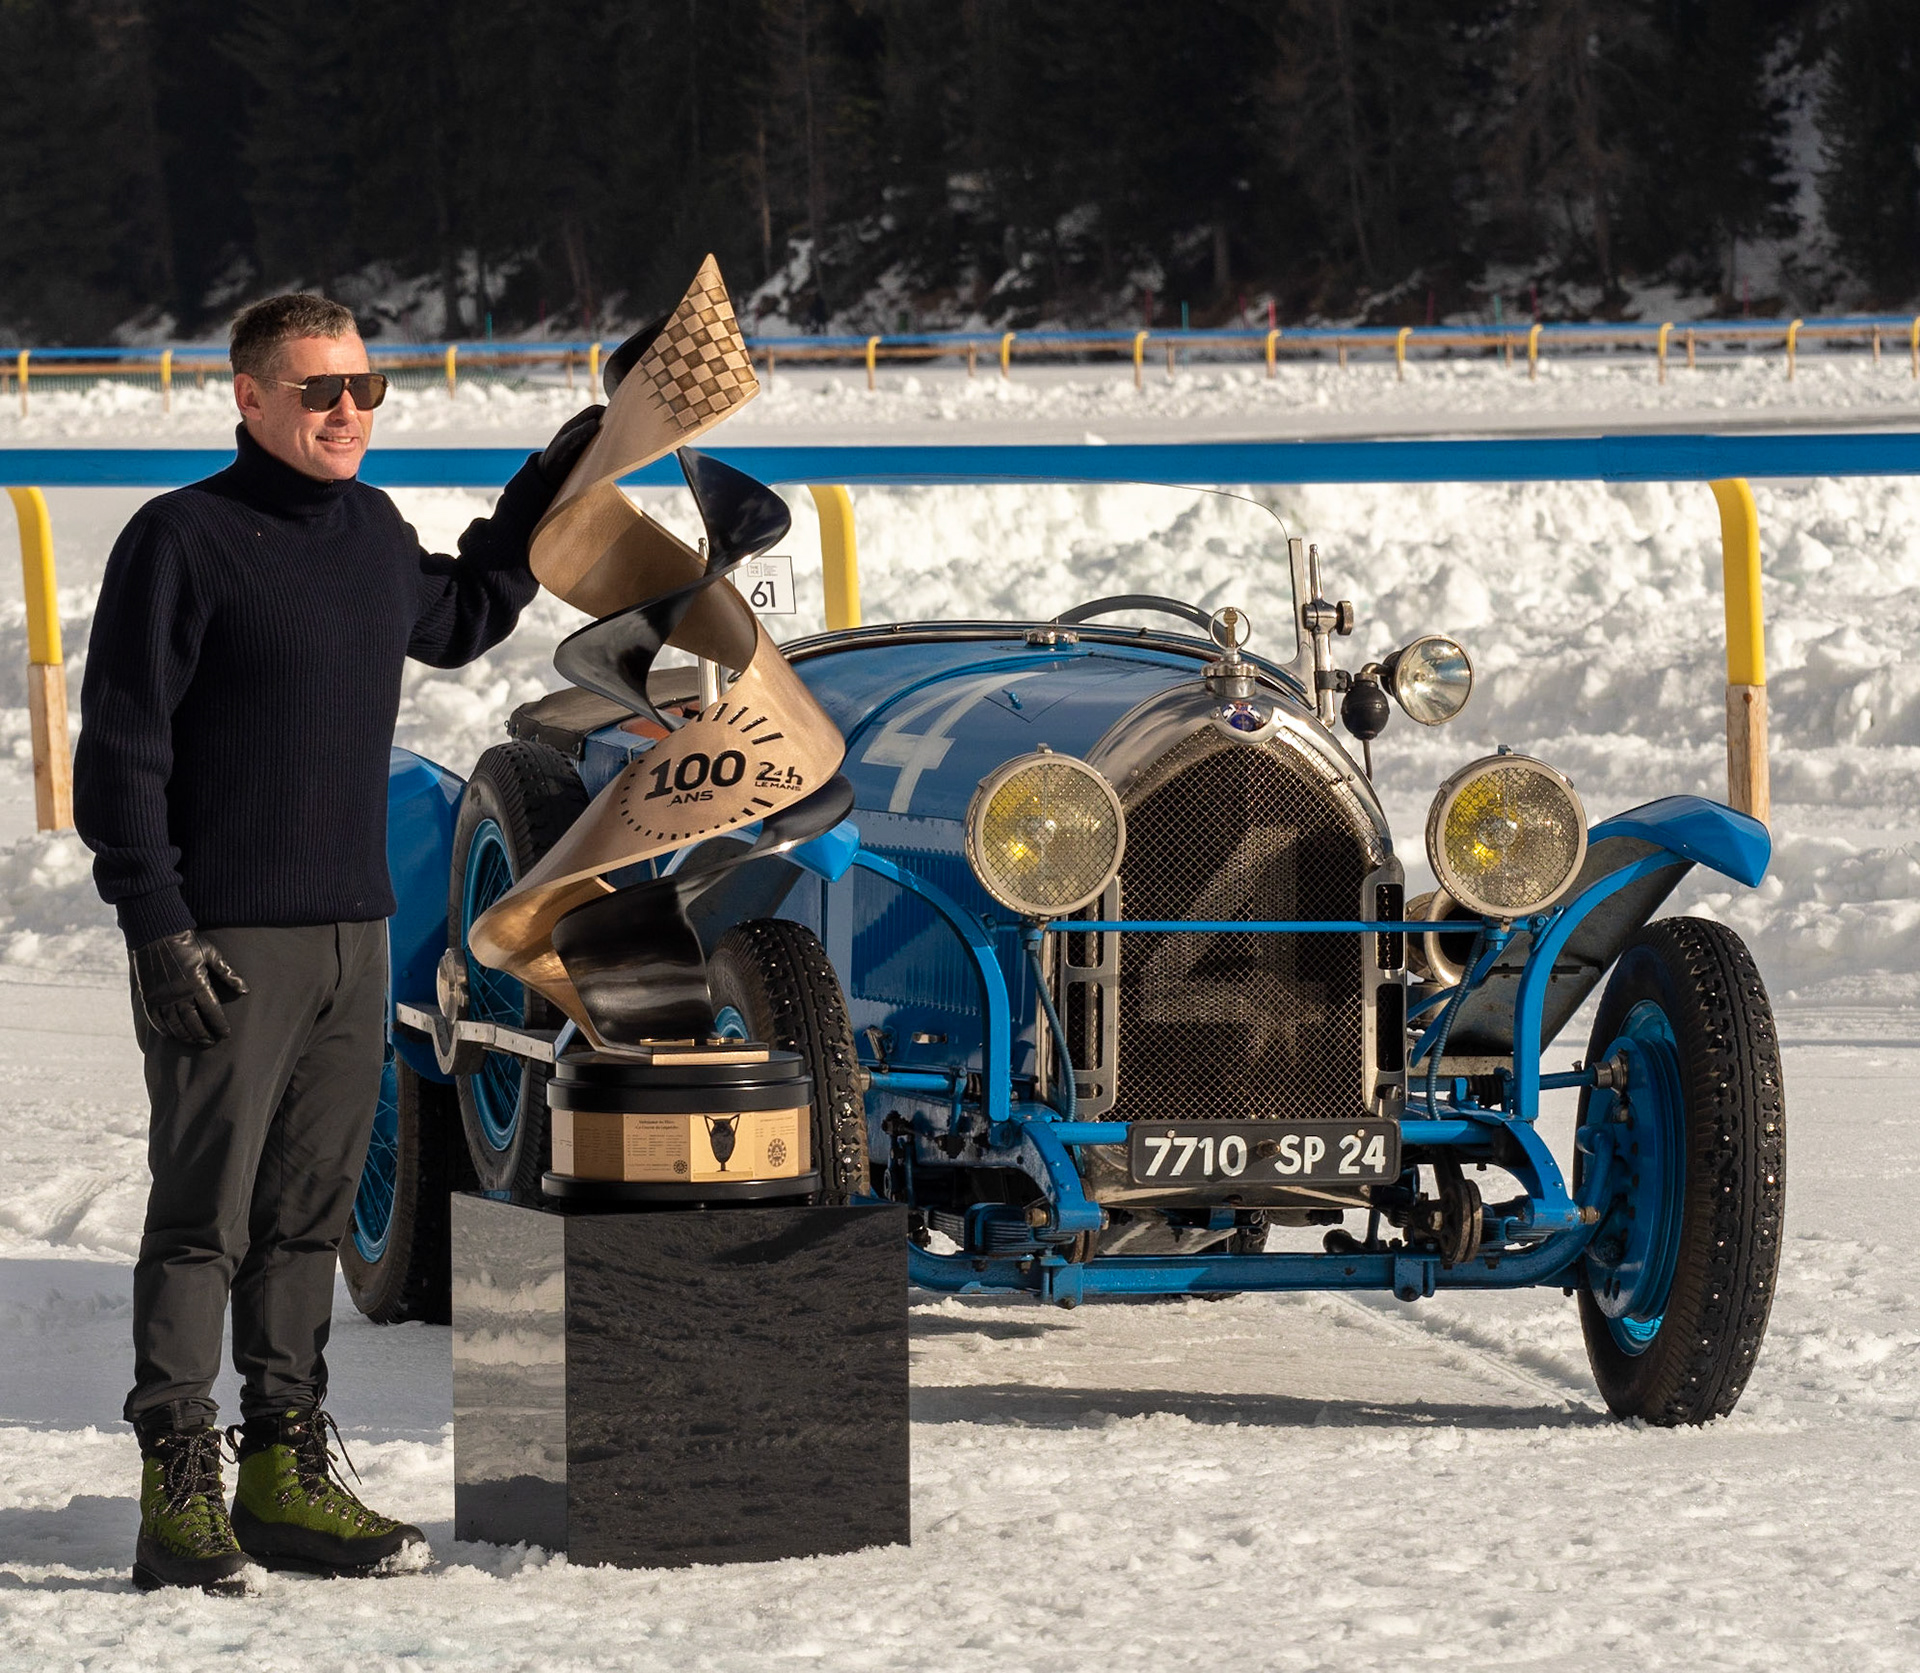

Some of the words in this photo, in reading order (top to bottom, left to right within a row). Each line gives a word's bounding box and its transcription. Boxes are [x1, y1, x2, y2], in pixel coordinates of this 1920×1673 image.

[750, 581, 776, 608] 61
[861, 671, 1049, 814] 4
[644, 750, 747, 801] 100
[769, 782, 802, 792] MANS
[667, 790, 714, 808] ANS
[1144, 1134, 1248, 1177] 7710
[1274, 1134, 1326, 1176] SP
[1338, 1134, 1386, 1175] 24
